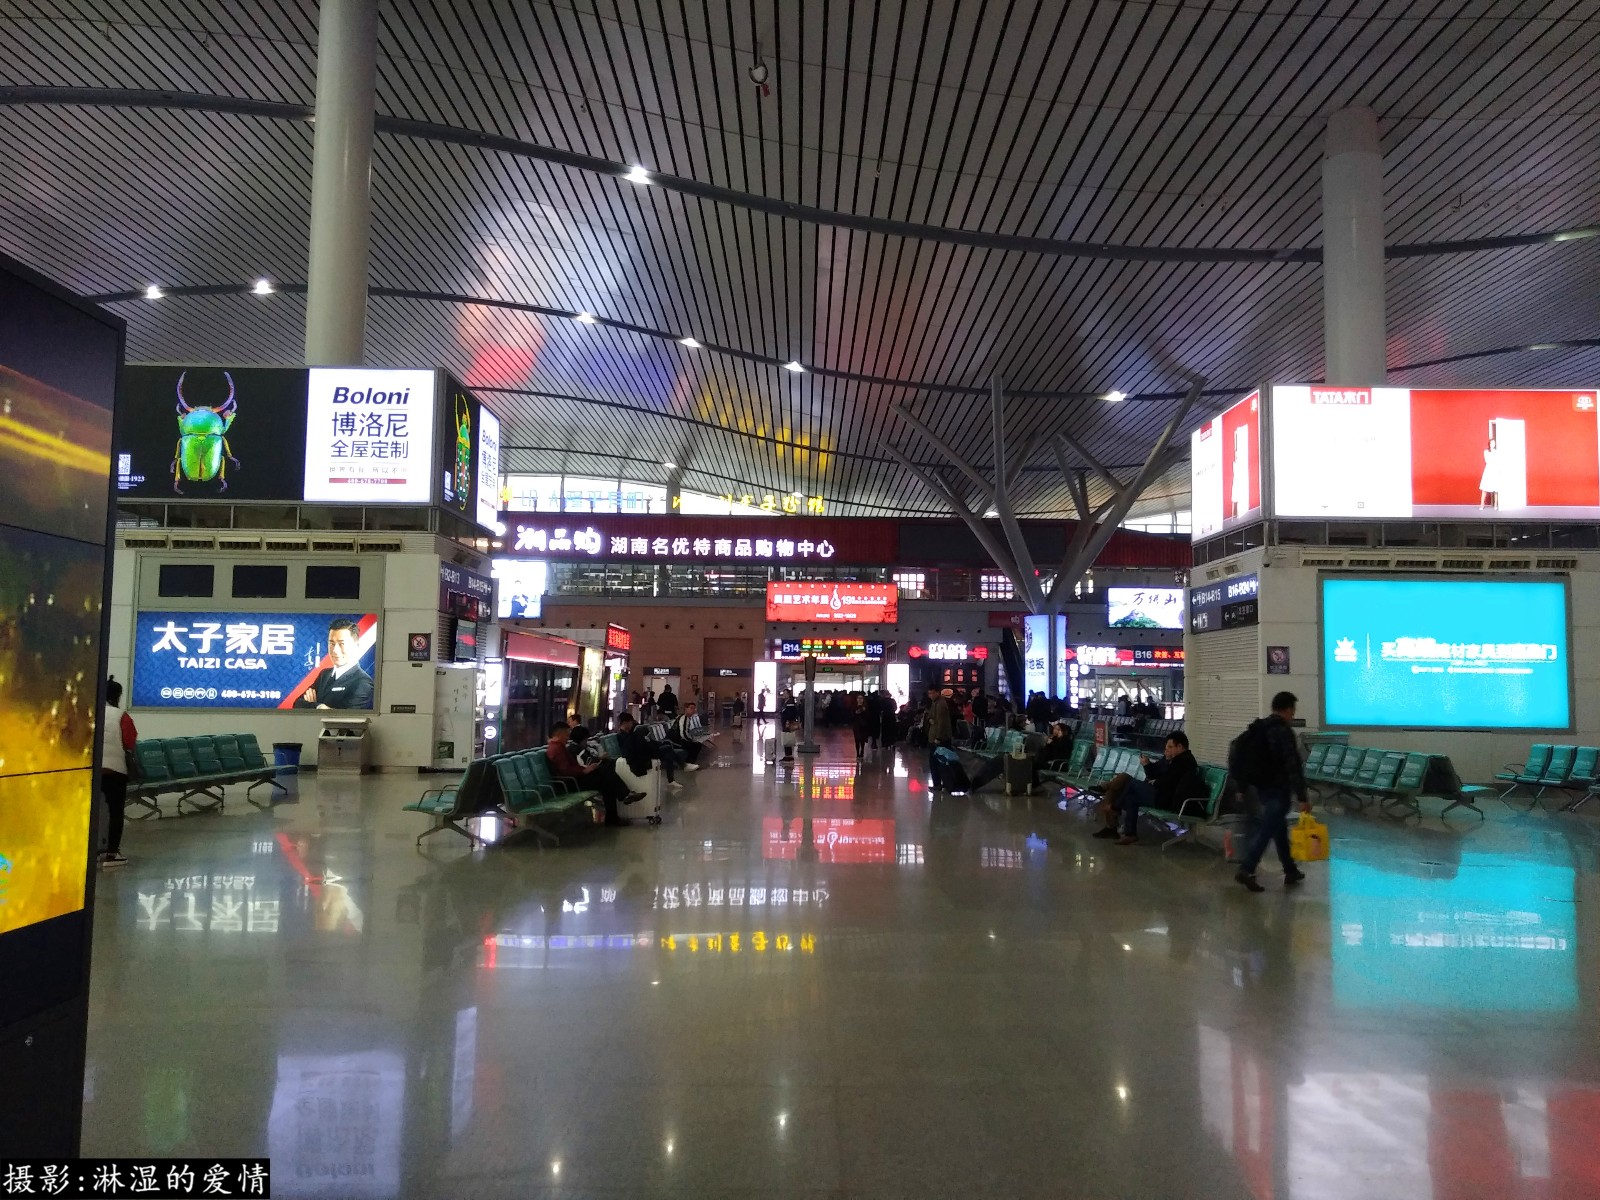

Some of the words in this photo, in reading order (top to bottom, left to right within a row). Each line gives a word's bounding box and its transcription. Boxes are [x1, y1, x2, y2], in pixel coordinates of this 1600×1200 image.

[332, 386, 410, 404] Boloni
[331, 411, 409, 437] 博洛尼
[330, 439, 408, 459] 全屋定制
[610, 536, 835, 558] 湖南名优特商品购物中心
[152, 621, 295, 655] 太子家居
[783, 643, 800, 653] B14
[866, 644, 883, 654] B15
[1135, 650, 1152, 659] B16
[177, 657, 221, 669] TAIZI
[224, 657, 268, 670] CASA
